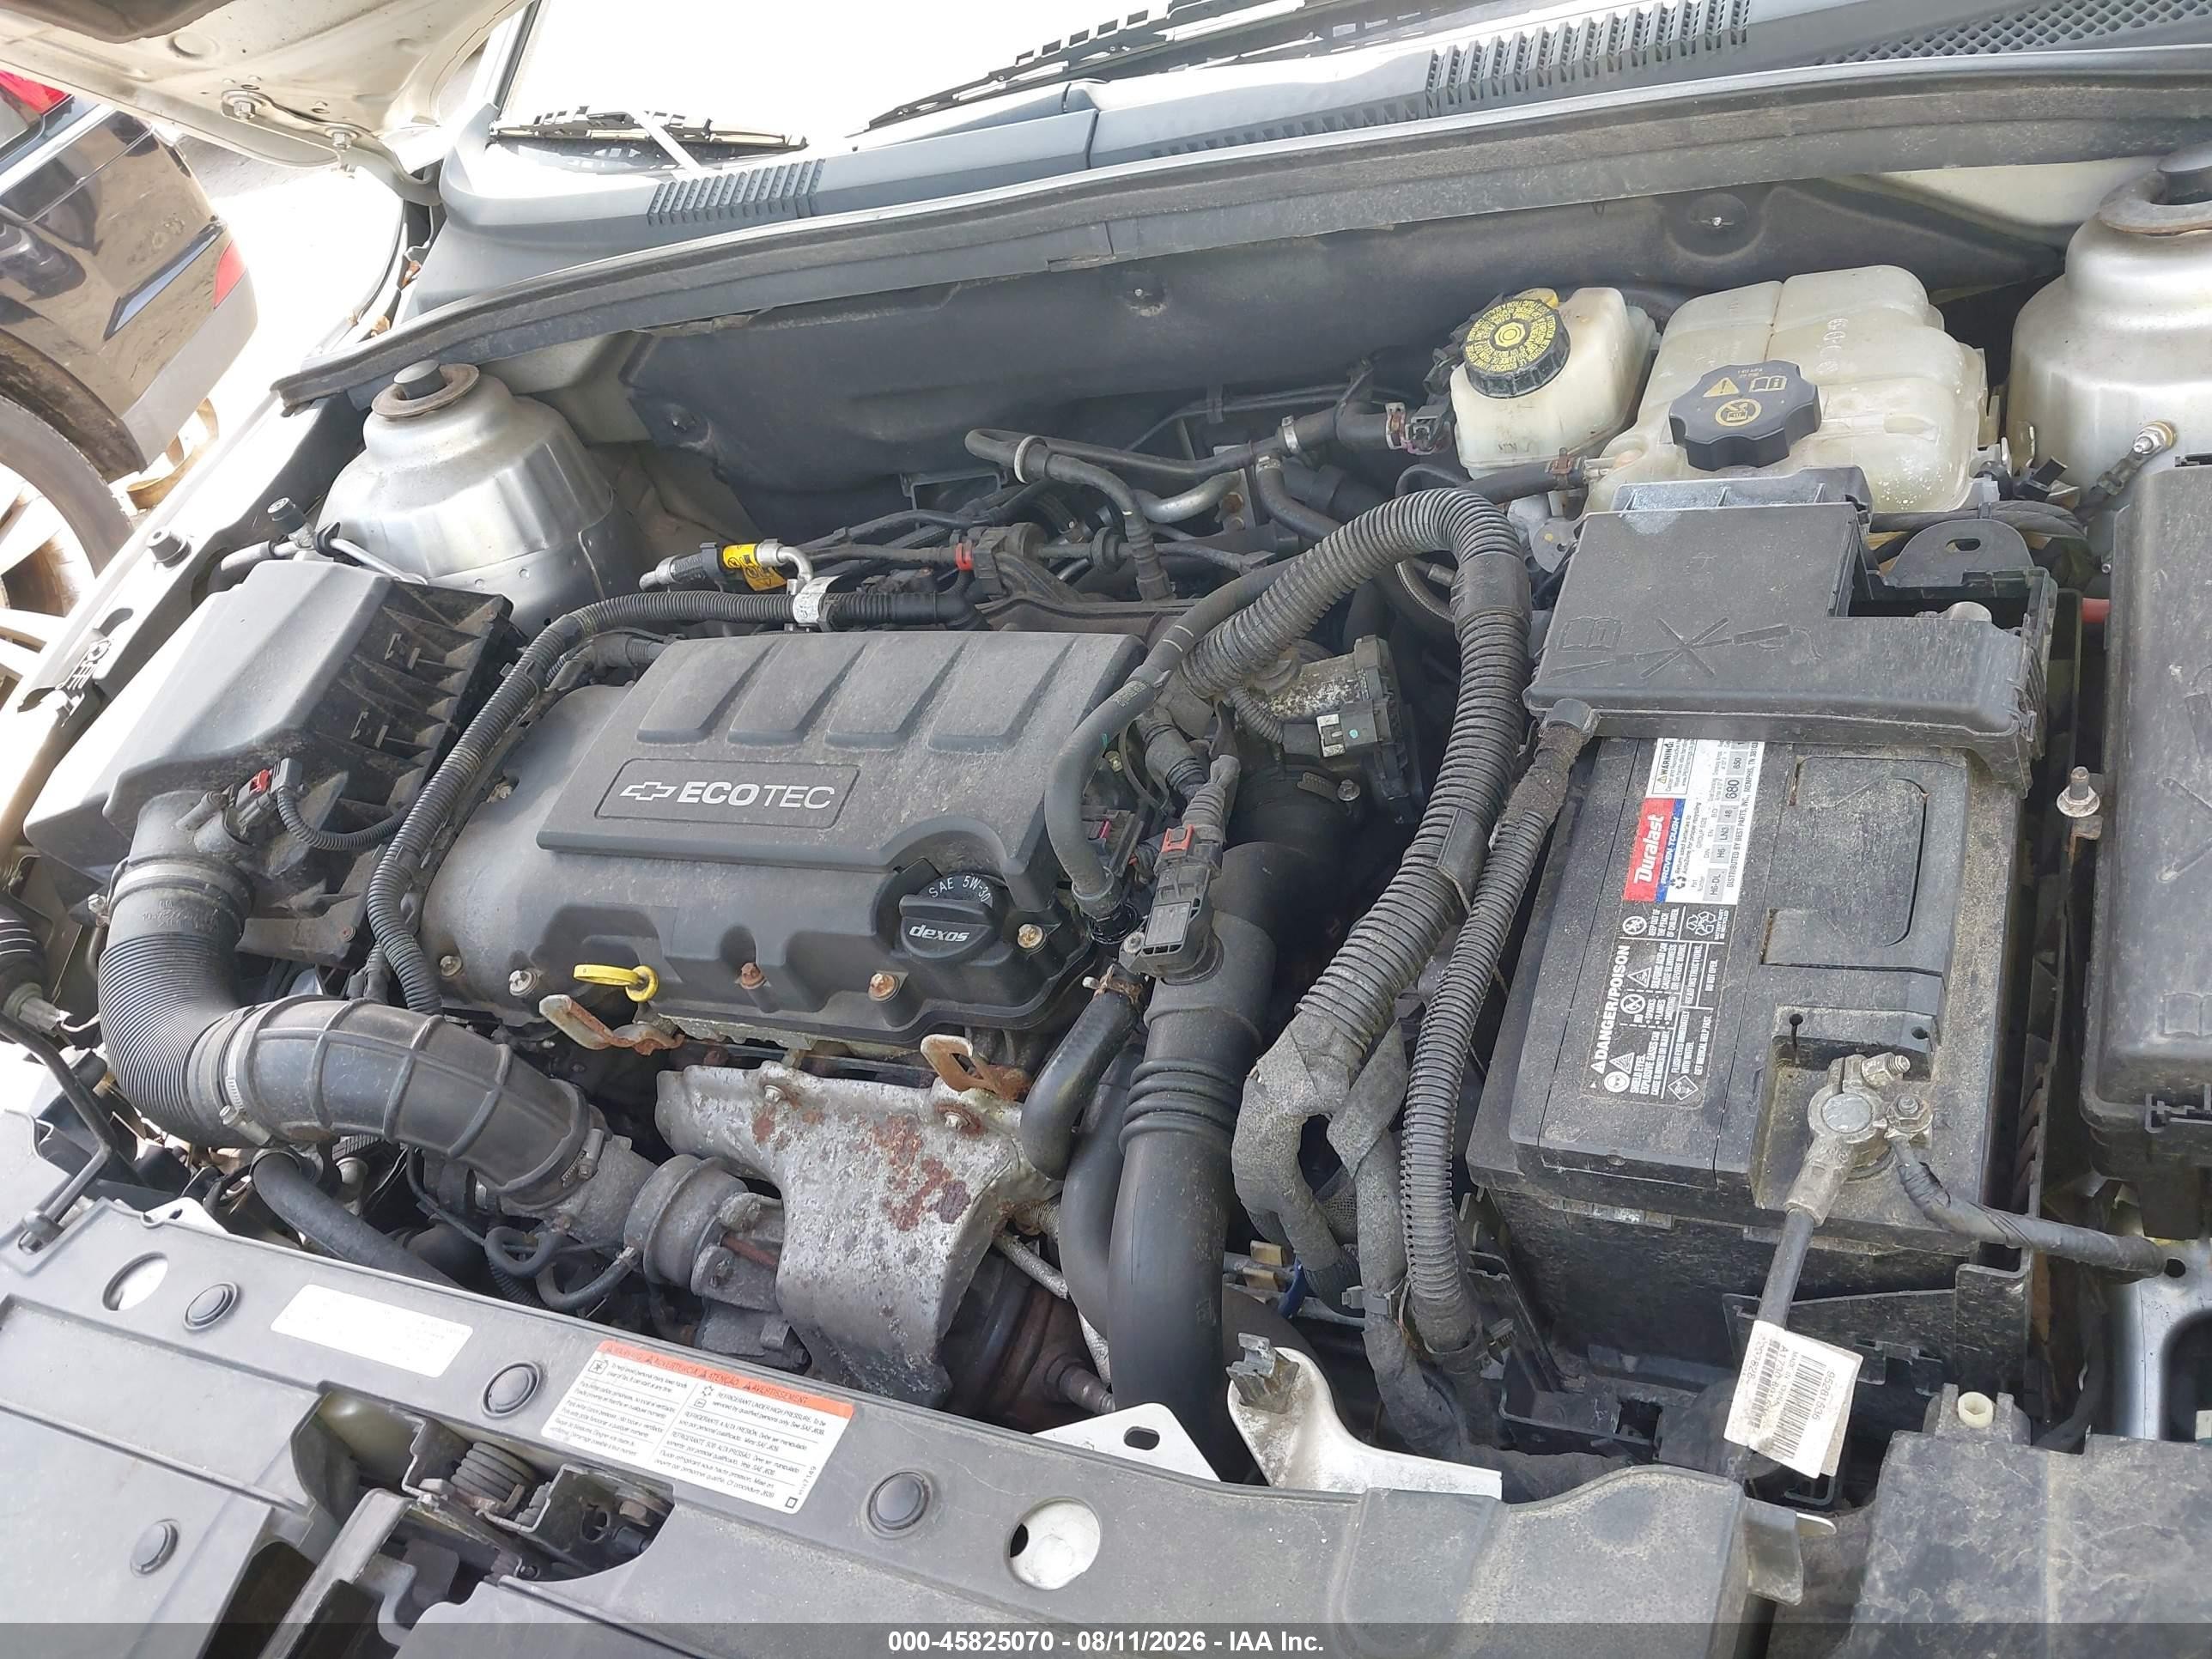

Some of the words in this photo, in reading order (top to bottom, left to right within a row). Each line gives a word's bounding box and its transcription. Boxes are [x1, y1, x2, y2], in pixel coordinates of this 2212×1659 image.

[677, 781, 836, 811] ECOTEC
[1724, 779, 1740, 798] 680
[1723, 809, 1732, 817] 48
[1736, 807, 1747, 826] PARTS,
[1719, 826, 1729, 840] LN3
[1734, 827, 1743, 841] BEST
[1633, 813, 1664, 884] Duralast
[1717, 848, 1726, 858] H6
[1726, 851, 1739, 887] DISTRIBUTED
[928, 877, 955, 899] SAE
[962, 874, 992, 904] 5W-30
[1709, 873, 1721, 895] H6-DL
[908, 924, 971, 943] dexos
[1672, 961, 1683, 981] SEVERE
[1687, 943, 1703, 987] INSTRUCTIONS.
[1661, 972, 1672, 989] CAUSE
[1594, 945, 1631, 1060] DANGER/POISON
[1684, 988, 1695, 1003] READ
[1654, 998, 1666, 1019] FLAMES
[1699, 1029, 1710, 1042] HELP
[1645, 1041, 1658, 1060] GASES
[1674, 1042, 1684, 1055] EYES
[1695, 1042, 1707, 1064] MEDICAL
[1670, 1056, 1681, 1073] FLUSH
[1693, 1064, 1704, 1075] GET
[1629, 1071, 1643, 1093] SHIELD
[1639, 1060, 1655, 1094] EXPLOSIVE
[1650, 1079, 1661, 1095] CAUSE
